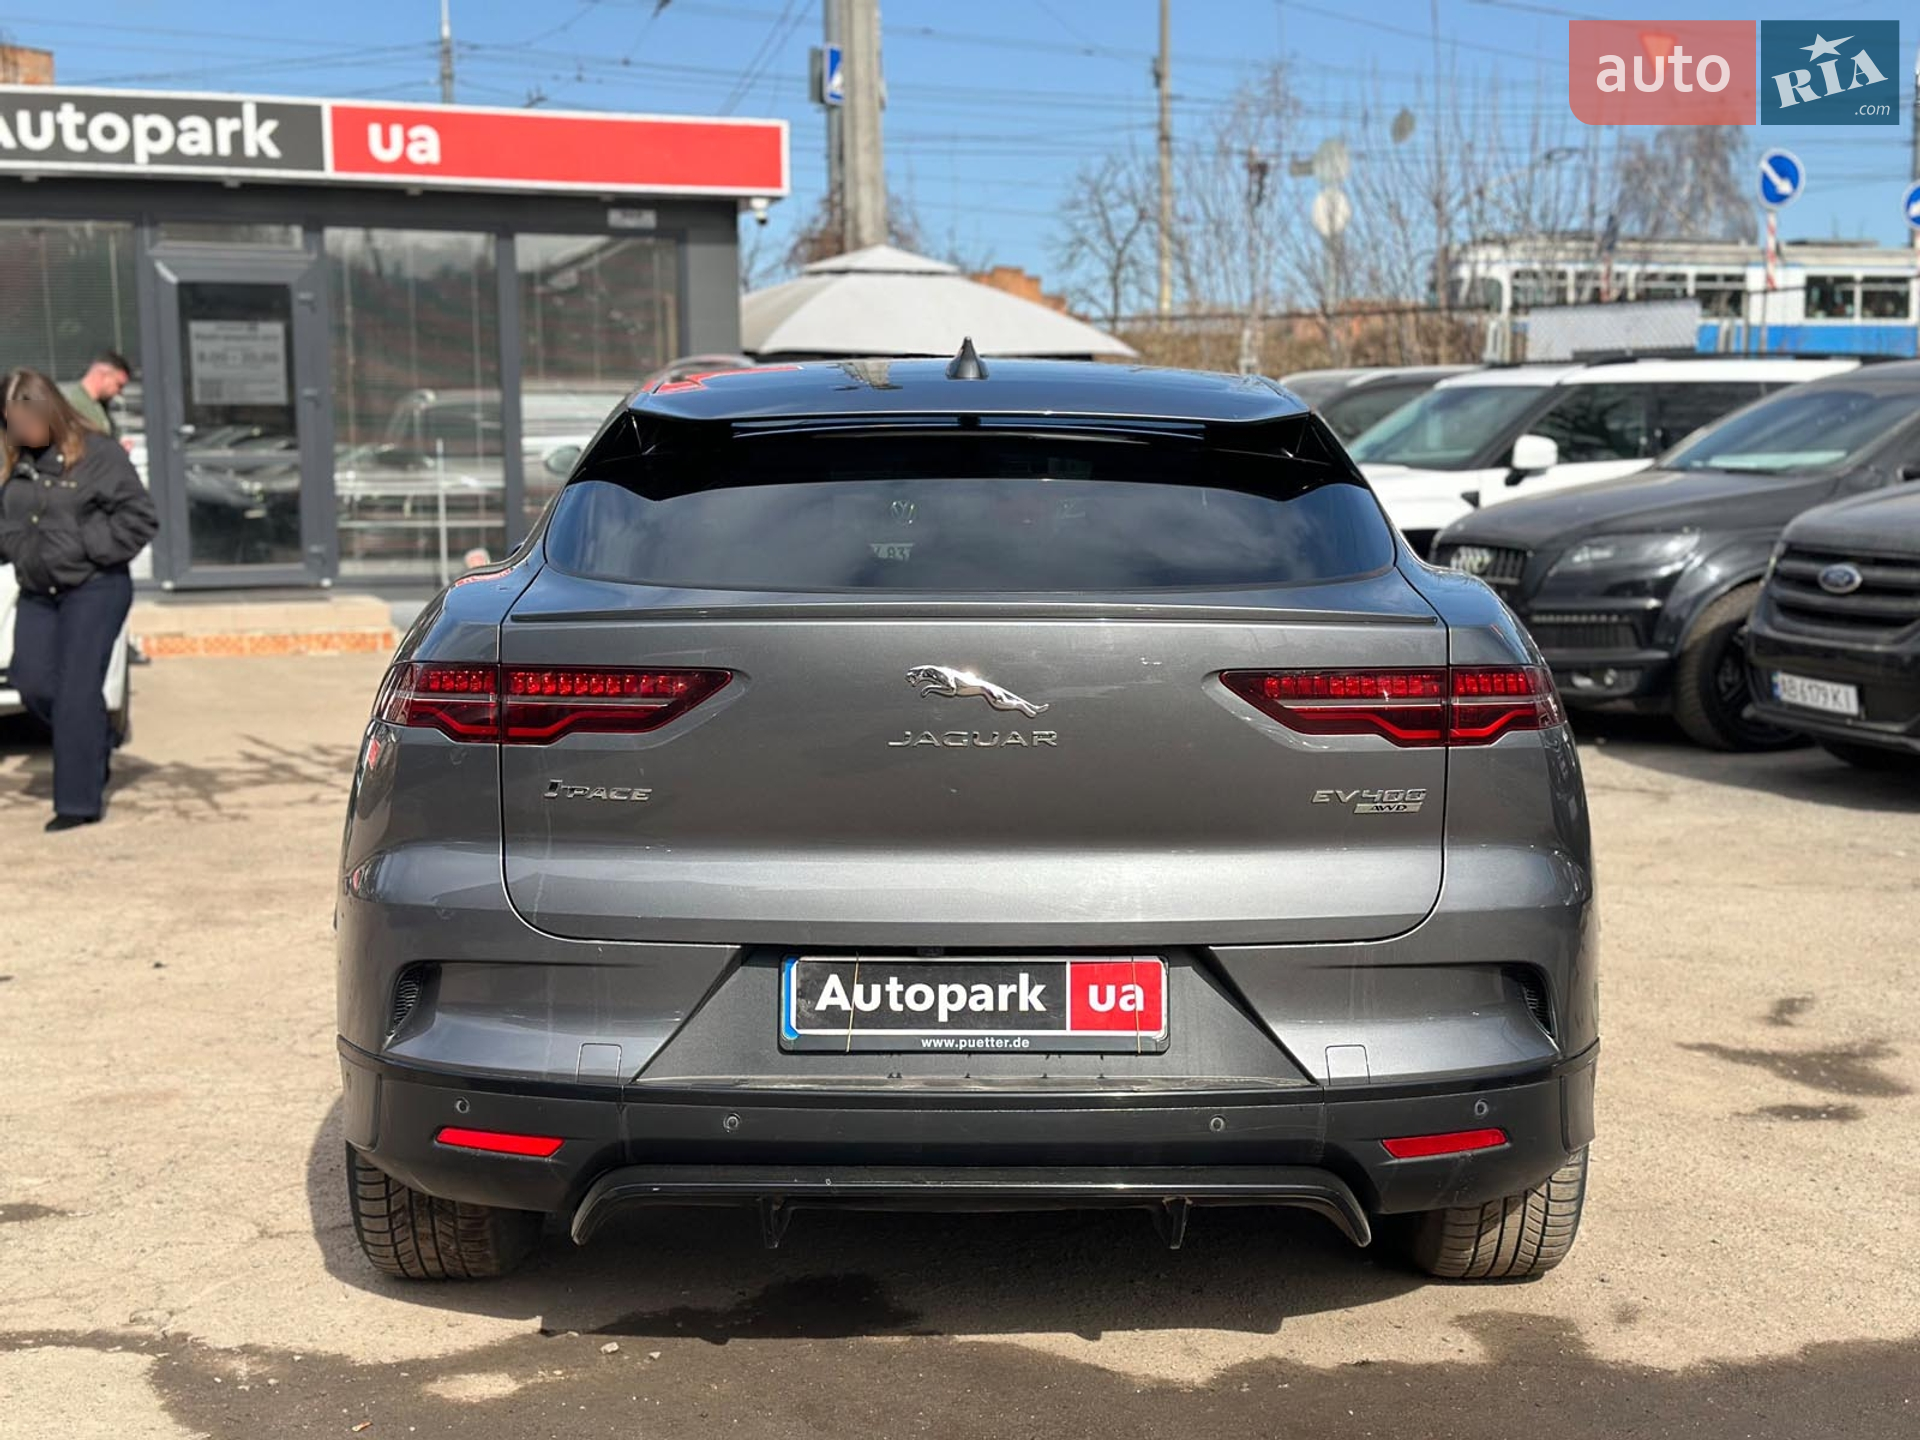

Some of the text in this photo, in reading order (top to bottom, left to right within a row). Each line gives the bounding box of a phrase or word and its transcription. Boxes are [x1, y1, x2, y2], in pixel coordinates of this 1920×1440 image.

[367, 122, 441, 165] ua
[887, 730, 1058, 747] JAGUAR
[1371, 804, 1408, 812] AWD
[815, 973, 1145, 1022] Autopark ua
[921, 1037, 1030, 1049] www.puetter.de
